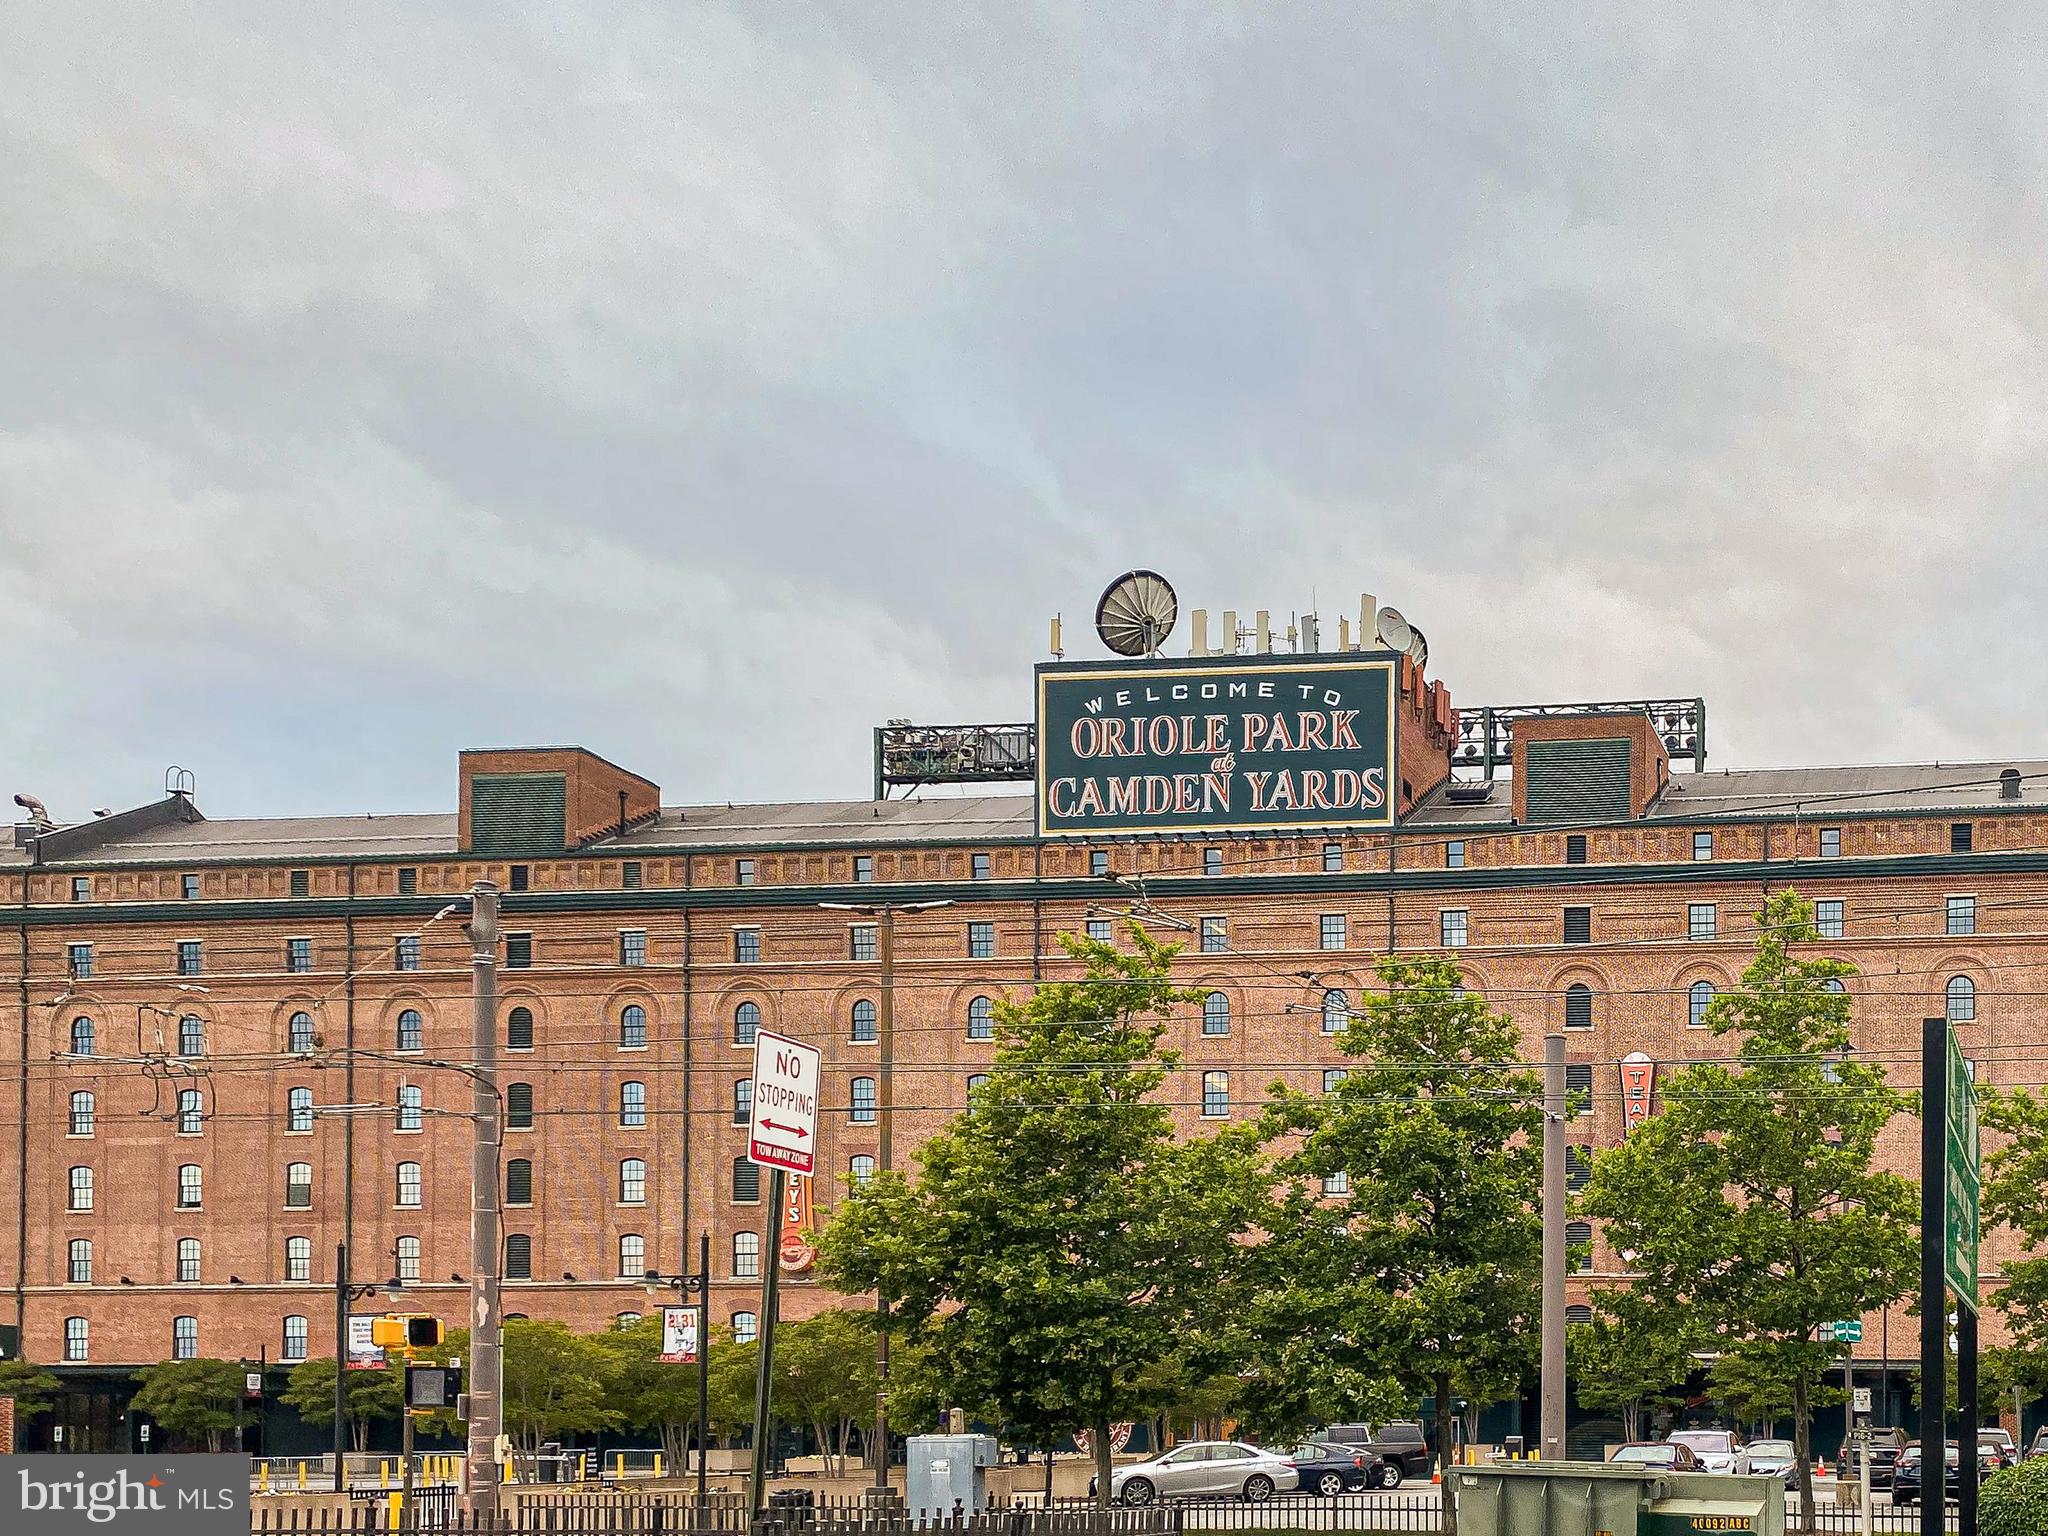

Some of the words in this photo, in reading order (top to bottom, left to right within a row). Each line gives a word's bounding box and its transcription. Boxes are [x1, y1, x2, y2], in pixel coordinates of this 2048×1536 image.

[1085, 682, 1274, 715] WELCOME
[1298, 684, 1342, 708] TO
[1071, 714, 1230, 758] ORIOLE
[1241, 710, 1361, 753] PARK
[1211, 752, 1236, 773] at
[1048, 773, 1231, 818] CAMDEN
[1244, 767, 1385, 811] YARDS
[776, 1051, 801, 1079] NO
[758, 1082, 813, 1117] STOPPING
[755, 1143, 773, 1157] TOW
[772, 1146, 792, 1163] AWAY
[791, 1152, 809, 1167] ZONE
[1728, 1517, 1749, 1529] ABC
